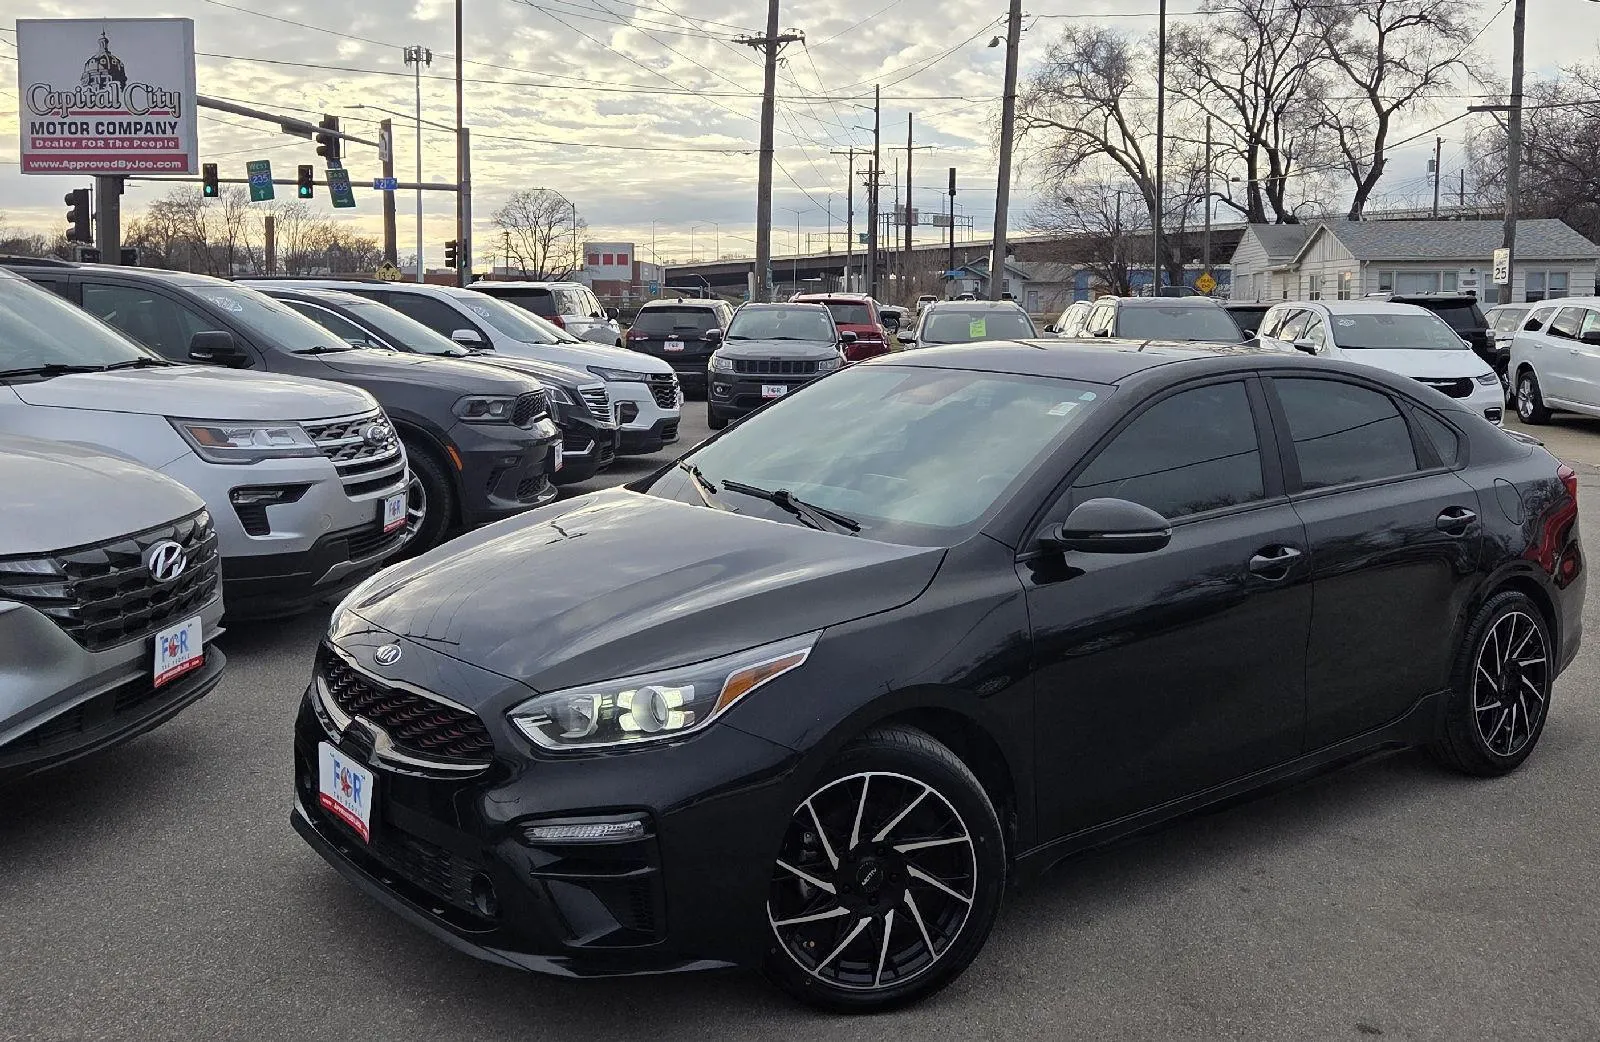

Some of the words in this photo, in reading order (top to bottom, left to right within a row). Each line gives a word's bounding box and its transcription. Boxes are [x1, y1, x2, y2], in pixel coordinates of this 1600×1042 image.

[26, 82, 121, 118] Capital
[124, 83, 181, 118] City
[30, 121, 90, 135] MOTOR
[95, 121, 178, 135] COMPANY
[35, 139, 77, 148] Dealer
[81, 139, 105, 148] FOR
[107, 139, 130, 148] The
[133, 139, 176, 149] People
[29, 160, 182, 170] www.ApprovedByJoe.com
[252, 174, 269, 183] 235
[1495, 267, 1507, 280] 25
[161, 629, 189, 662] FOR
[333, 759, 363, 808] FOR
